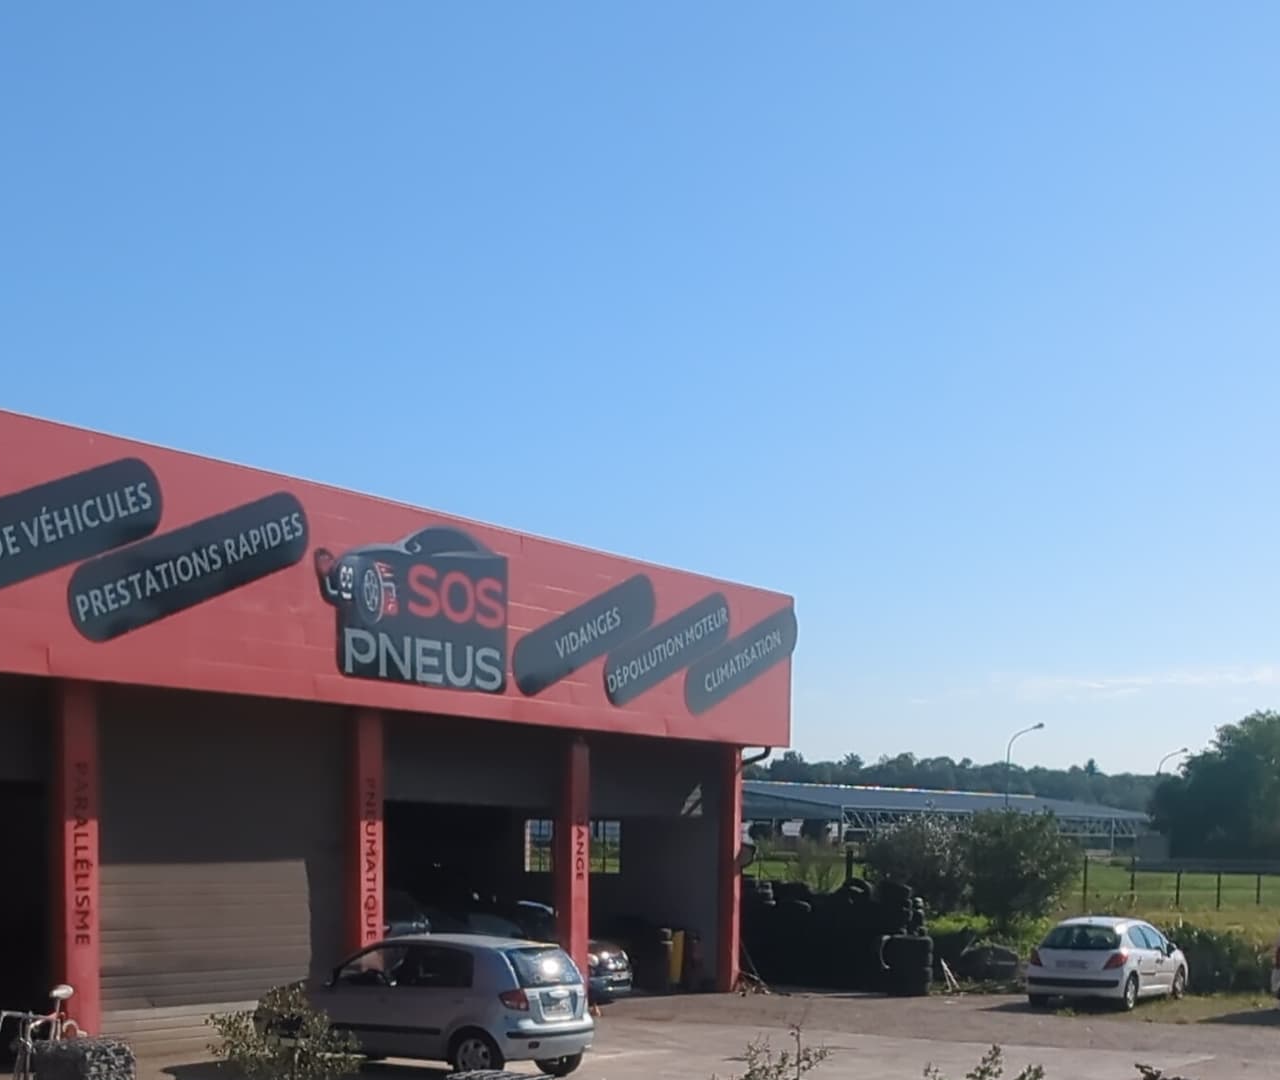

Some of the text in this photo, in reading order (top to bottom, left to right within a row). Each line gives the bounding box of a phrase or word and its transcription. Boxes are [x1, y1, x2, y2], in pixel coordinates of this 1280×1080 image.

[20, 482, 152, 548] VÉHICULES
[75, 512, 304, 622] PRESTATIONS RAPIDES
[407, 564, 505, 629] SOS
[344, 627, 503, 692] PNEUS
[555, 607, 621, 659] VIDANGES
[607, 607, 729, 693] DÉPOLLUTION MOTEUR
[704, 629, 782, 692] CLIMATISATION
[73, 761, 91, 945] PARALLÉLISME
[364, 777, 377, 940] PNEUMATIQUE
